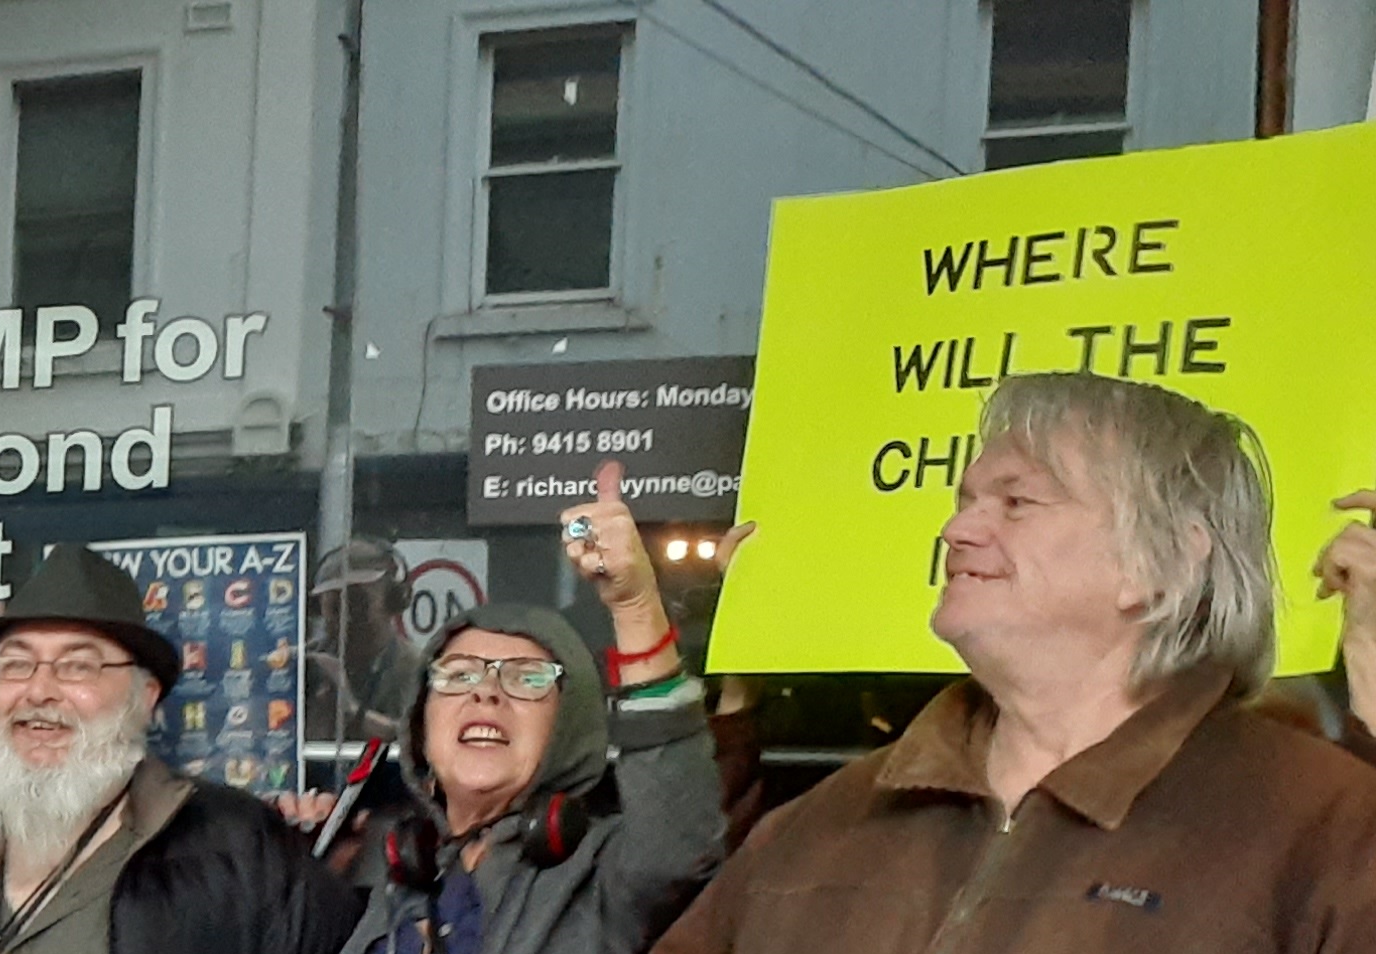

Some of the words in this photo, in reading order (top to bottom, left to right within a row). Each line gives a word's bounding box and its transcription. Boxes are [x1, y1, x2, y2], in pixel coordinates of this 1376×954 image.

[924, 219, 1180, 297] WHERE
[115, 298, 268, 384] for
[893, 331, 1016, 394] WILL
[1067, 317, 1232, 377] THE
[486, 389, 560, 414] Office
[564, 388, 649, 411] Hours:
[656, 383, 756, 411] Monday
[484, 433, 527, 456] Ph:
[532, 430, 591, 455] 9415
[596, 428, 654, 452] 8901
[872, 433, 976, 493] CHI
[483, 475, 509, 499] E:
[149, 547, 234, 579] YOUR
[238, 543, 296, 574] A-Z
